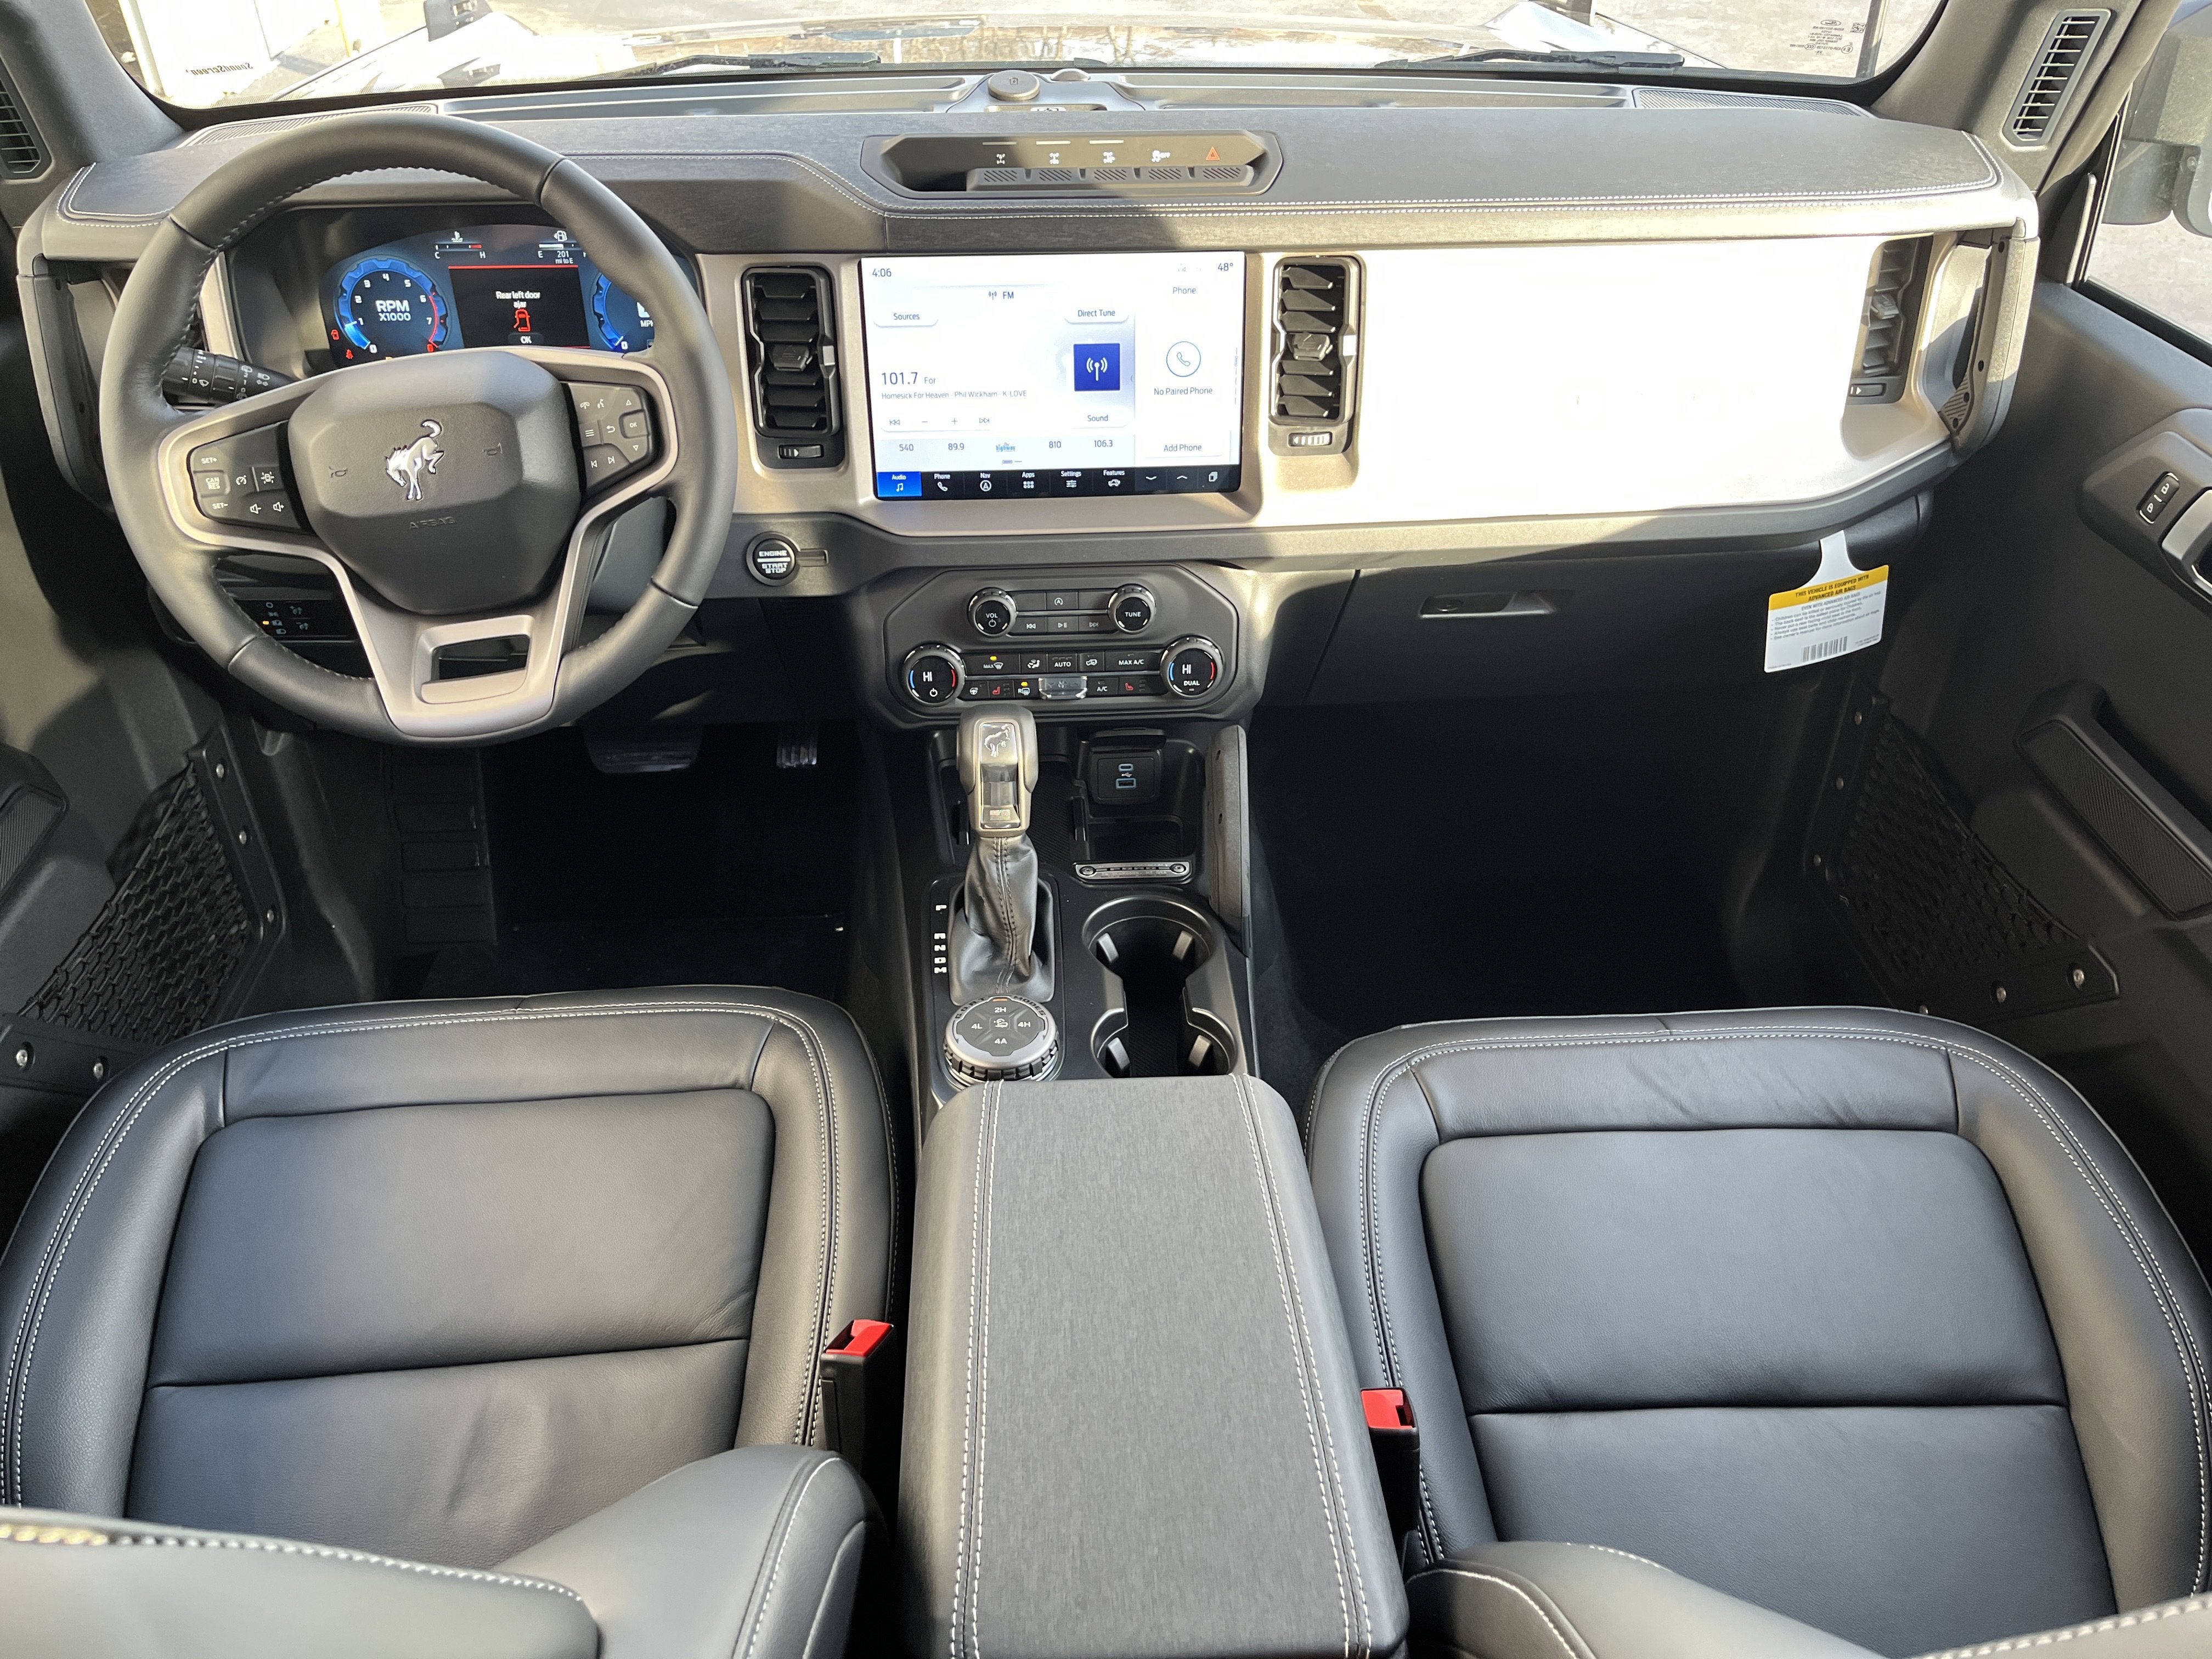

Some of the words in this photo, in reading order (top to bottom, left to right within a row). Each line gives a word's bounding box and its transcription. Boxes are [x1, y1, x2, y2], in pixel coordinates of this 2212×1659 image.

[538, 250, 543, 258] E
[1217, 262, 1234, 272] 48°
[382, 273, 390, 281] 4
[872, 268, 892, 278] 4:06
[363, 279, 371, 288] 3
[404, 279, 411, 287] 5
[1172, 286, 1197, 295] Phone
[354, 295, 363, 303] 2
[419, 295, 427, 303] 6
[495, 291, 512, 300] Rear
[512, 291, 524, 299] left
[524, 291, 541, 299] door
[1002, 291, 1014, 300] FM
[375, 300, 410, 312] RPM
[514, 301, 527, 309] ajar
[379, 312, 411, 321] X1000
[1099, 309, 1116, 317] Tune
[358, 317, 364, 325] 1
[426, 317, 432, 325] 7
[521, 336, 532, 344] OK
[369, 344, 378, 353] 0
[620, 341, 628, 350] 0
[881, 371, 918, 385] 101.7
[881, 391, 912, 399] Homesick
[1165, 387, 1189, 396] Paired
[1189, 387, 1213, 395] Phone
[899, 443, 914, 452] 540
[947, 442, 965, 450] 89.9
[1048, 441, 1062, 449] 810
[1094, 439, 1113, 448] 106.3
[1163, 444, 1178, 452] Add
[1178, 443, 1202, 452] Phone
[201, 456, 218, 465] SET+
[1808, 586, 1827, 595] VEHICLE
[1835, 579, 1857, 588] EQUIPPED
[1808, 591, 1834, 601] ADVANCED
[1182, 664, 1192, 675] HI
[923, 671, 933, 682] HI
[1013, 996, 1046, 1016] MODES
